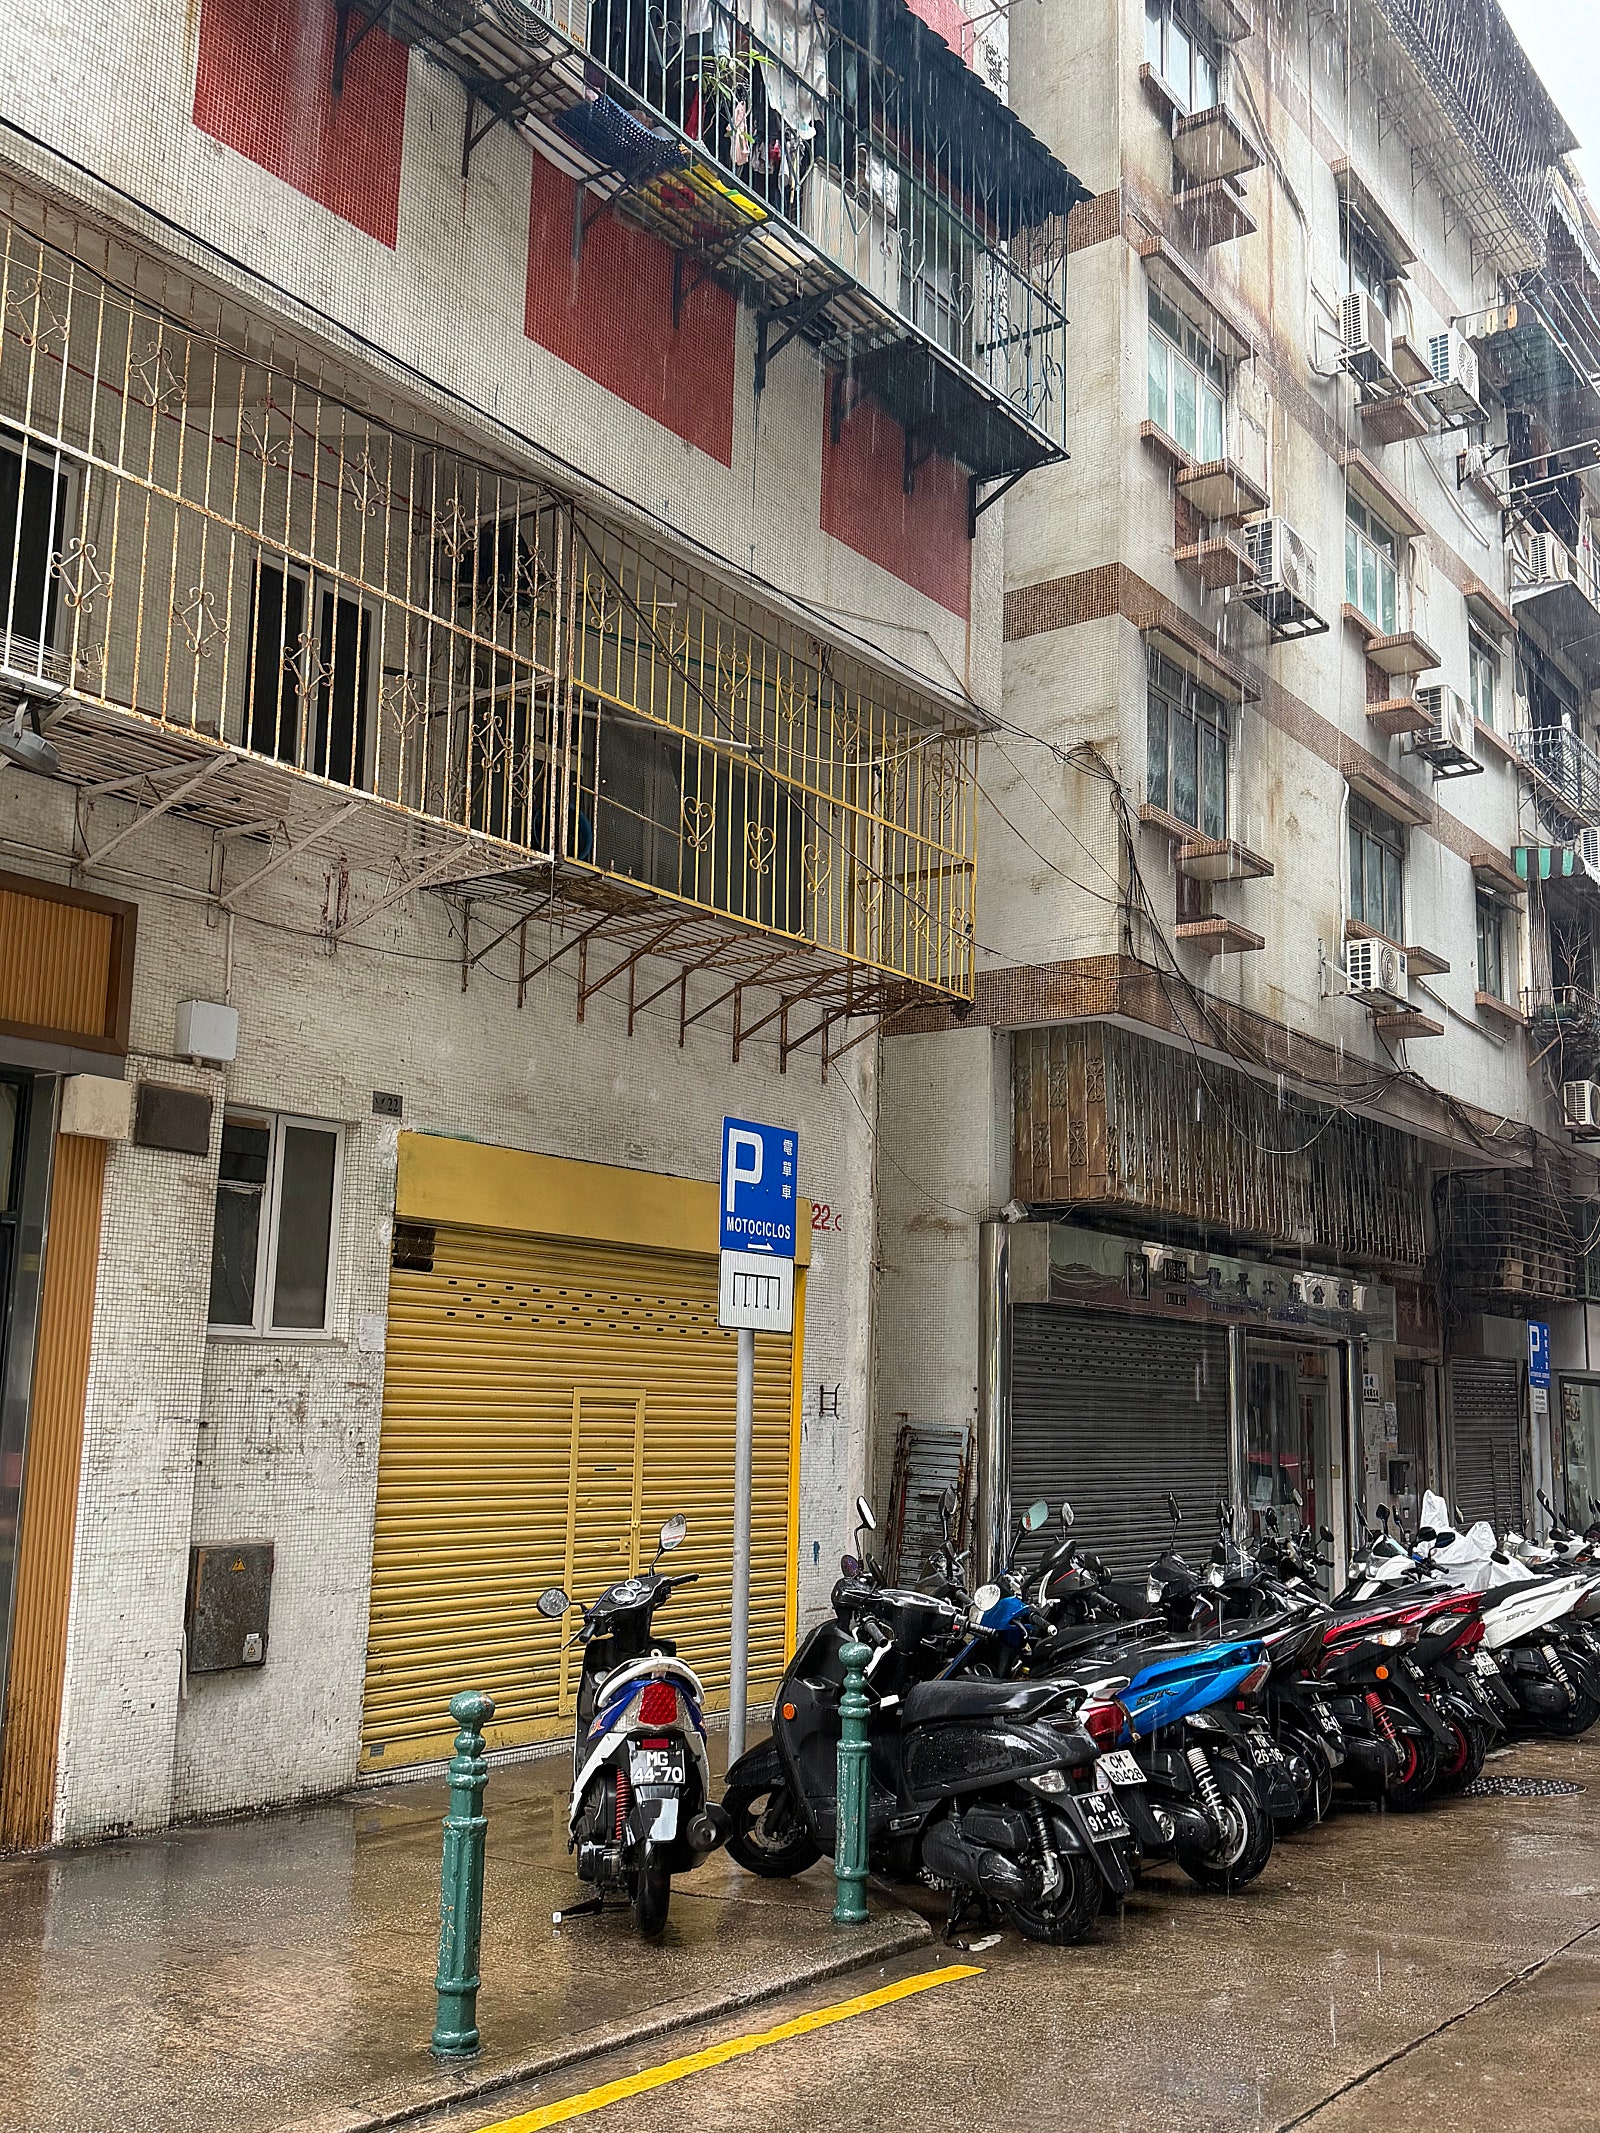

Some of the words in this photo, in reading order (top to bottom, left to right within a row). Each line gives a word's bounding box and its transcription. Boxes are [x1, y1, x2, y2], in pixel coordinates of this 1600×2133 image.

[726, 1127, 764, 1213] P
[781, 1138, 793, 1200] 電單車
[726, 1216, 791, 1240] MOTOCICLOS
[1529, 1325, 1540, 1367] P
[646, 1751, 669, 1766] MG
[1109, 1754, 1127, 1769] CM
[633, 1766, 683, 1783] 44-70
[1109, 1767, 1144, 1783] 80428
[1088, 1796, 1106, 1814] MS
[1088, 1810, 1123, 1832] 91-15
